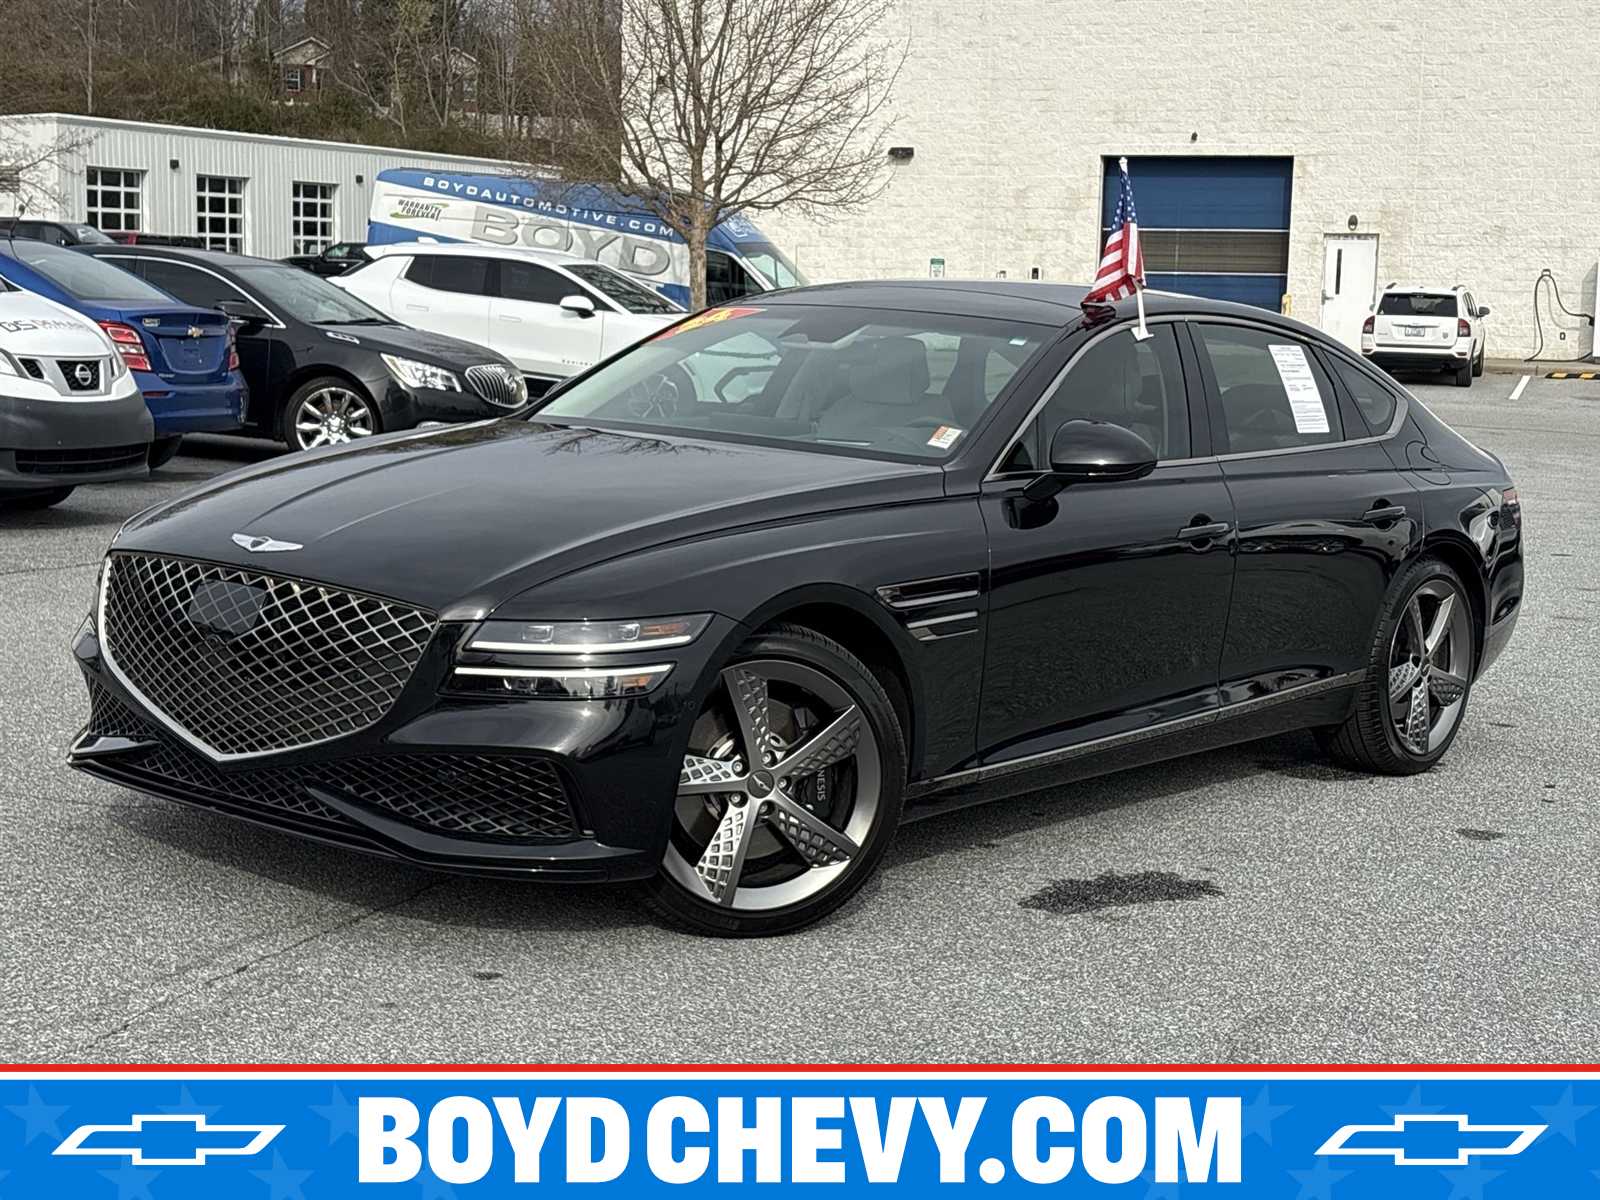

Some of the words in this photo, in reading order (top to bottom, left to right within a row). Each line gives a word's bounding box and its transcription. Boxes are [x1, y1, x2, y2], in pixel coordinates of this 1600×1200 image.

[422, 176, 675, 238] BOYDAUTOMOTIVE.COM
[471, 204, 671, 276] BOYD
[816, 768, 826, 801] NESIS
